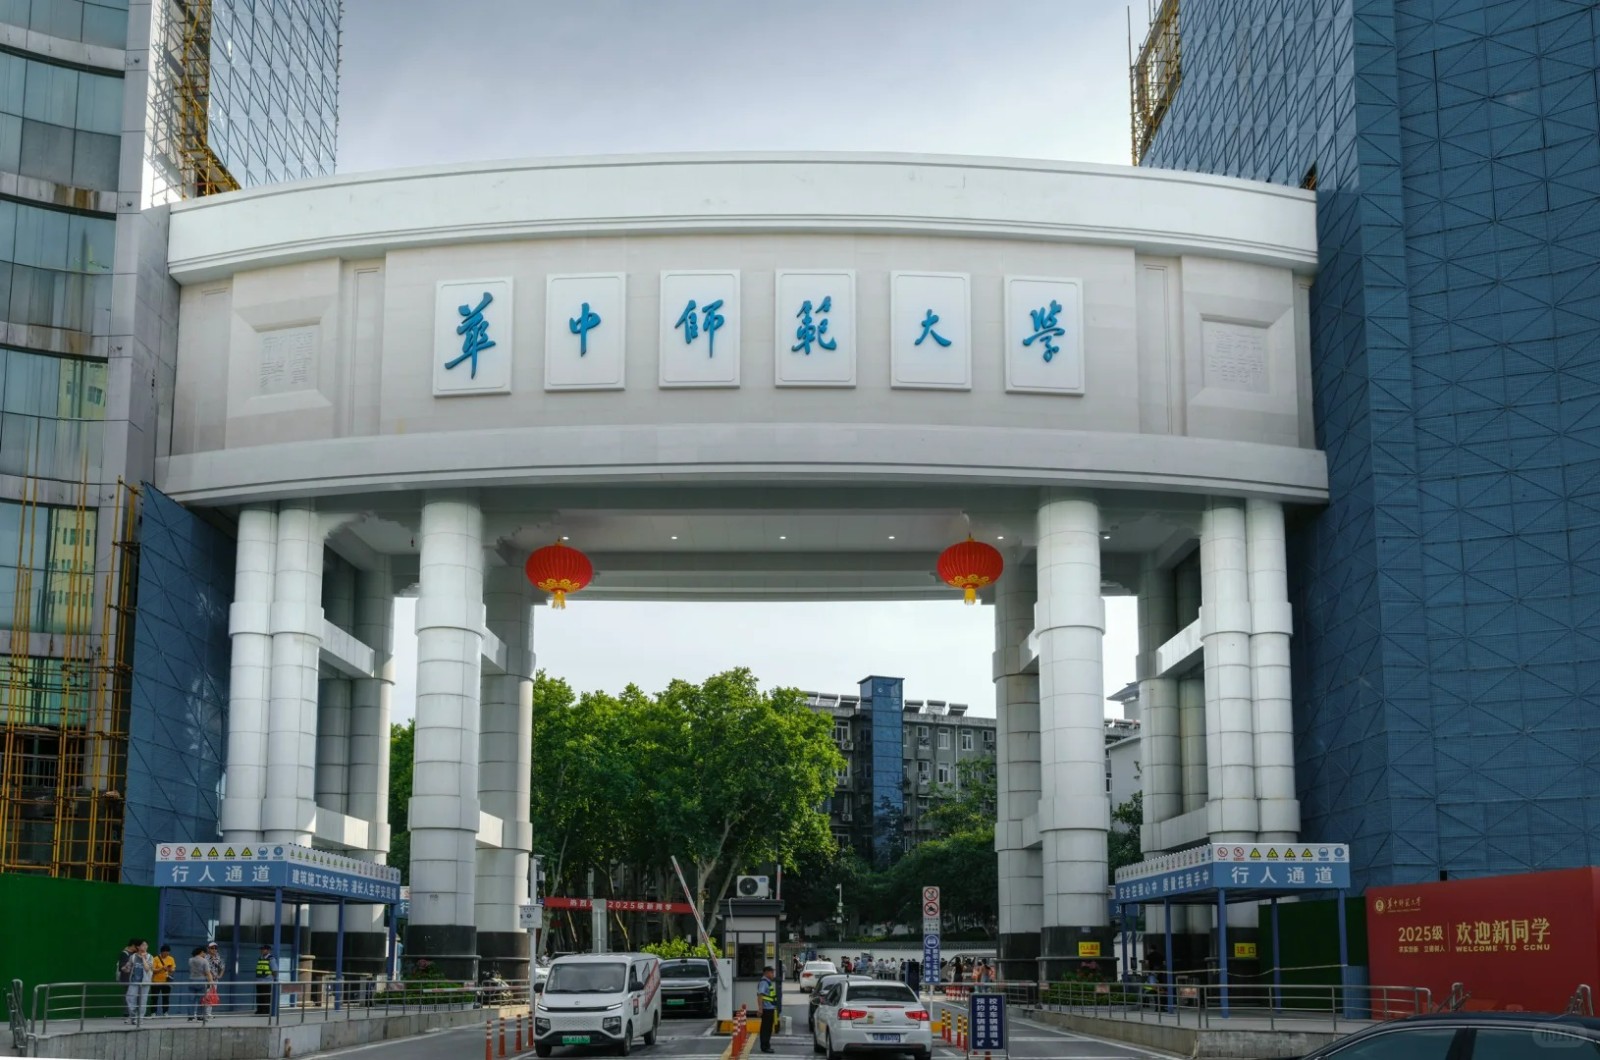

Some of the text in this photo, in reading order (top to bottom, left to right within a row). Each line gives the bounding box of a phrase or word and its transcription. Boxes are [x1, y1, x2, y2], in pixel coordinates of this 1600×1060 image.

[171, 864, 270, 883] 行人通道
[1231, 866, 1333, 884] 行人通道
[1398, 925, 1443, 942] 2025级
[1455, 917, 1551, 945] 欢迎新同学
[1455, 943, 1551, 953] WELCOME TO CCNU
[976, 997, 986, 1038] 预约车辆通道
[989, 997, 998, 1038] 校内车辆通道
